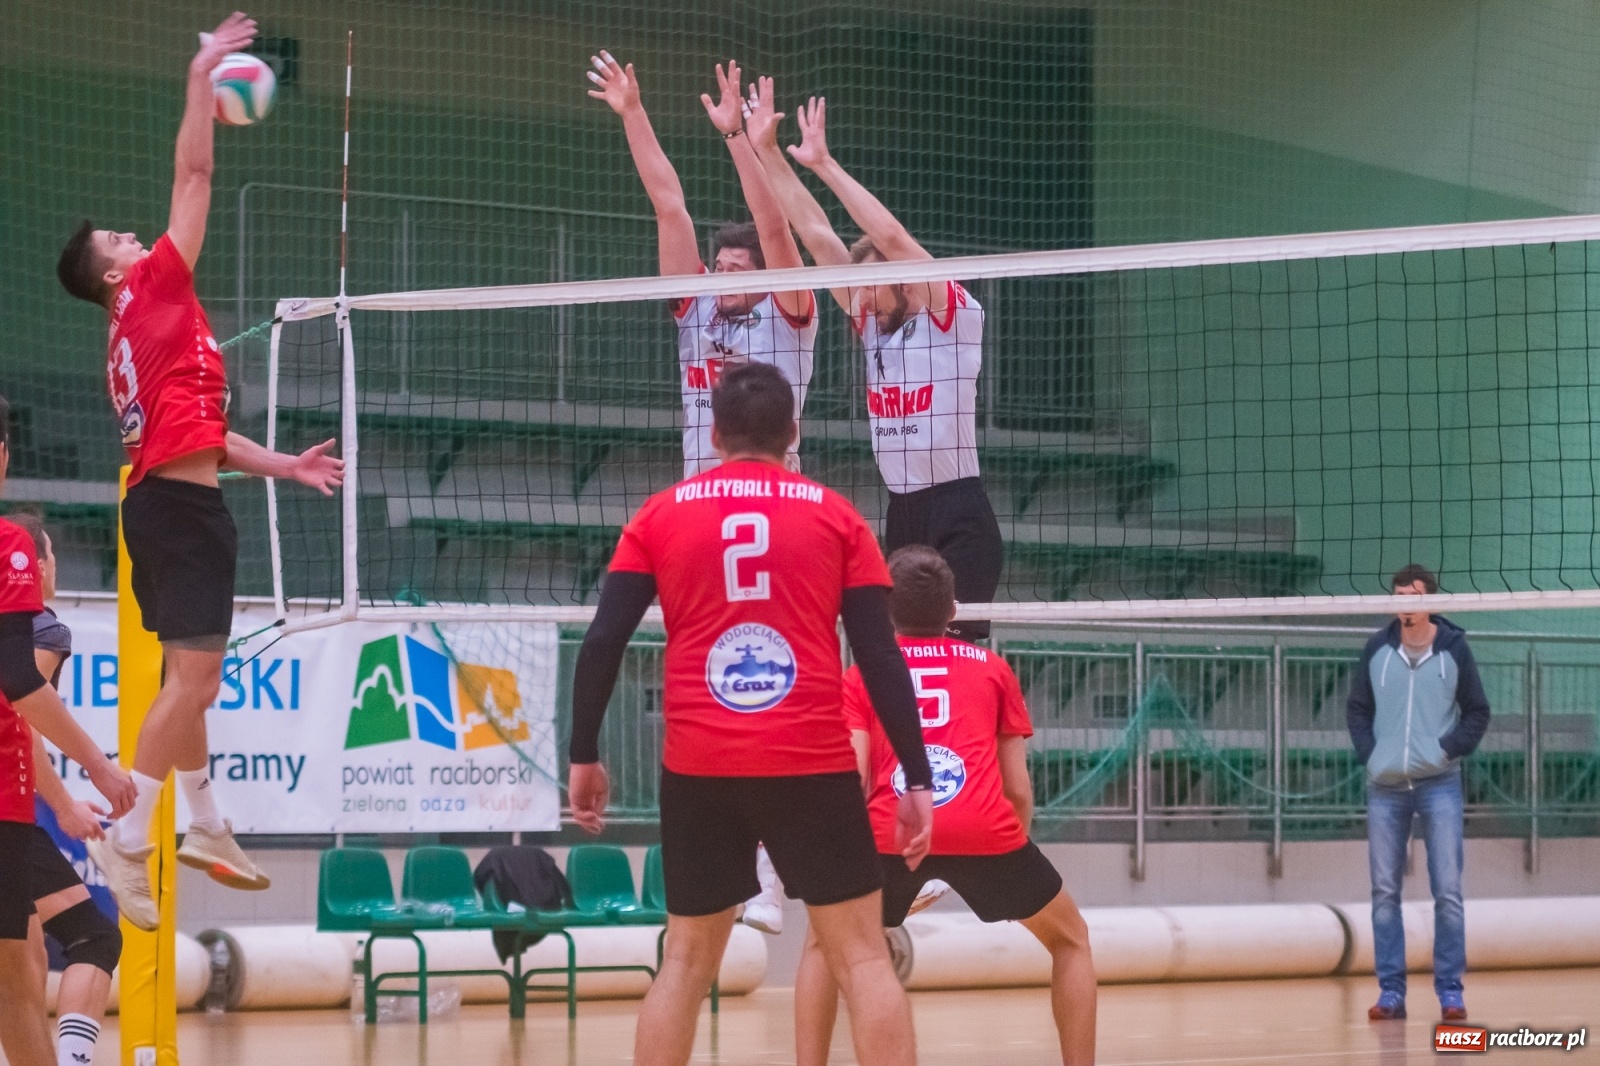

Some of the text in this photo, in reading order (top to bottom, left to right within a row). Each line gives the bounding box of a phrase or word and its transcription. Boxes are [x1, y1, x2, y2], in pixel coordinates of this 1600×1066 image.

[695, 399, 713, 409] GRU
[875, 426, 898, 437] GRUPA
[675, 479, 823, 503] VOLLEYBALL TEAM
[721, 512, 770, 602] 2
[950, 644, 987, 663] TEAM
[909, 667, 950, 728] 5
[208, 753, 305, 793] ramy
[342, 759, 533, 793] powiat raciborski
[342, 795, 407, 812] zielona
[420, 798, 465, 812] oaza
